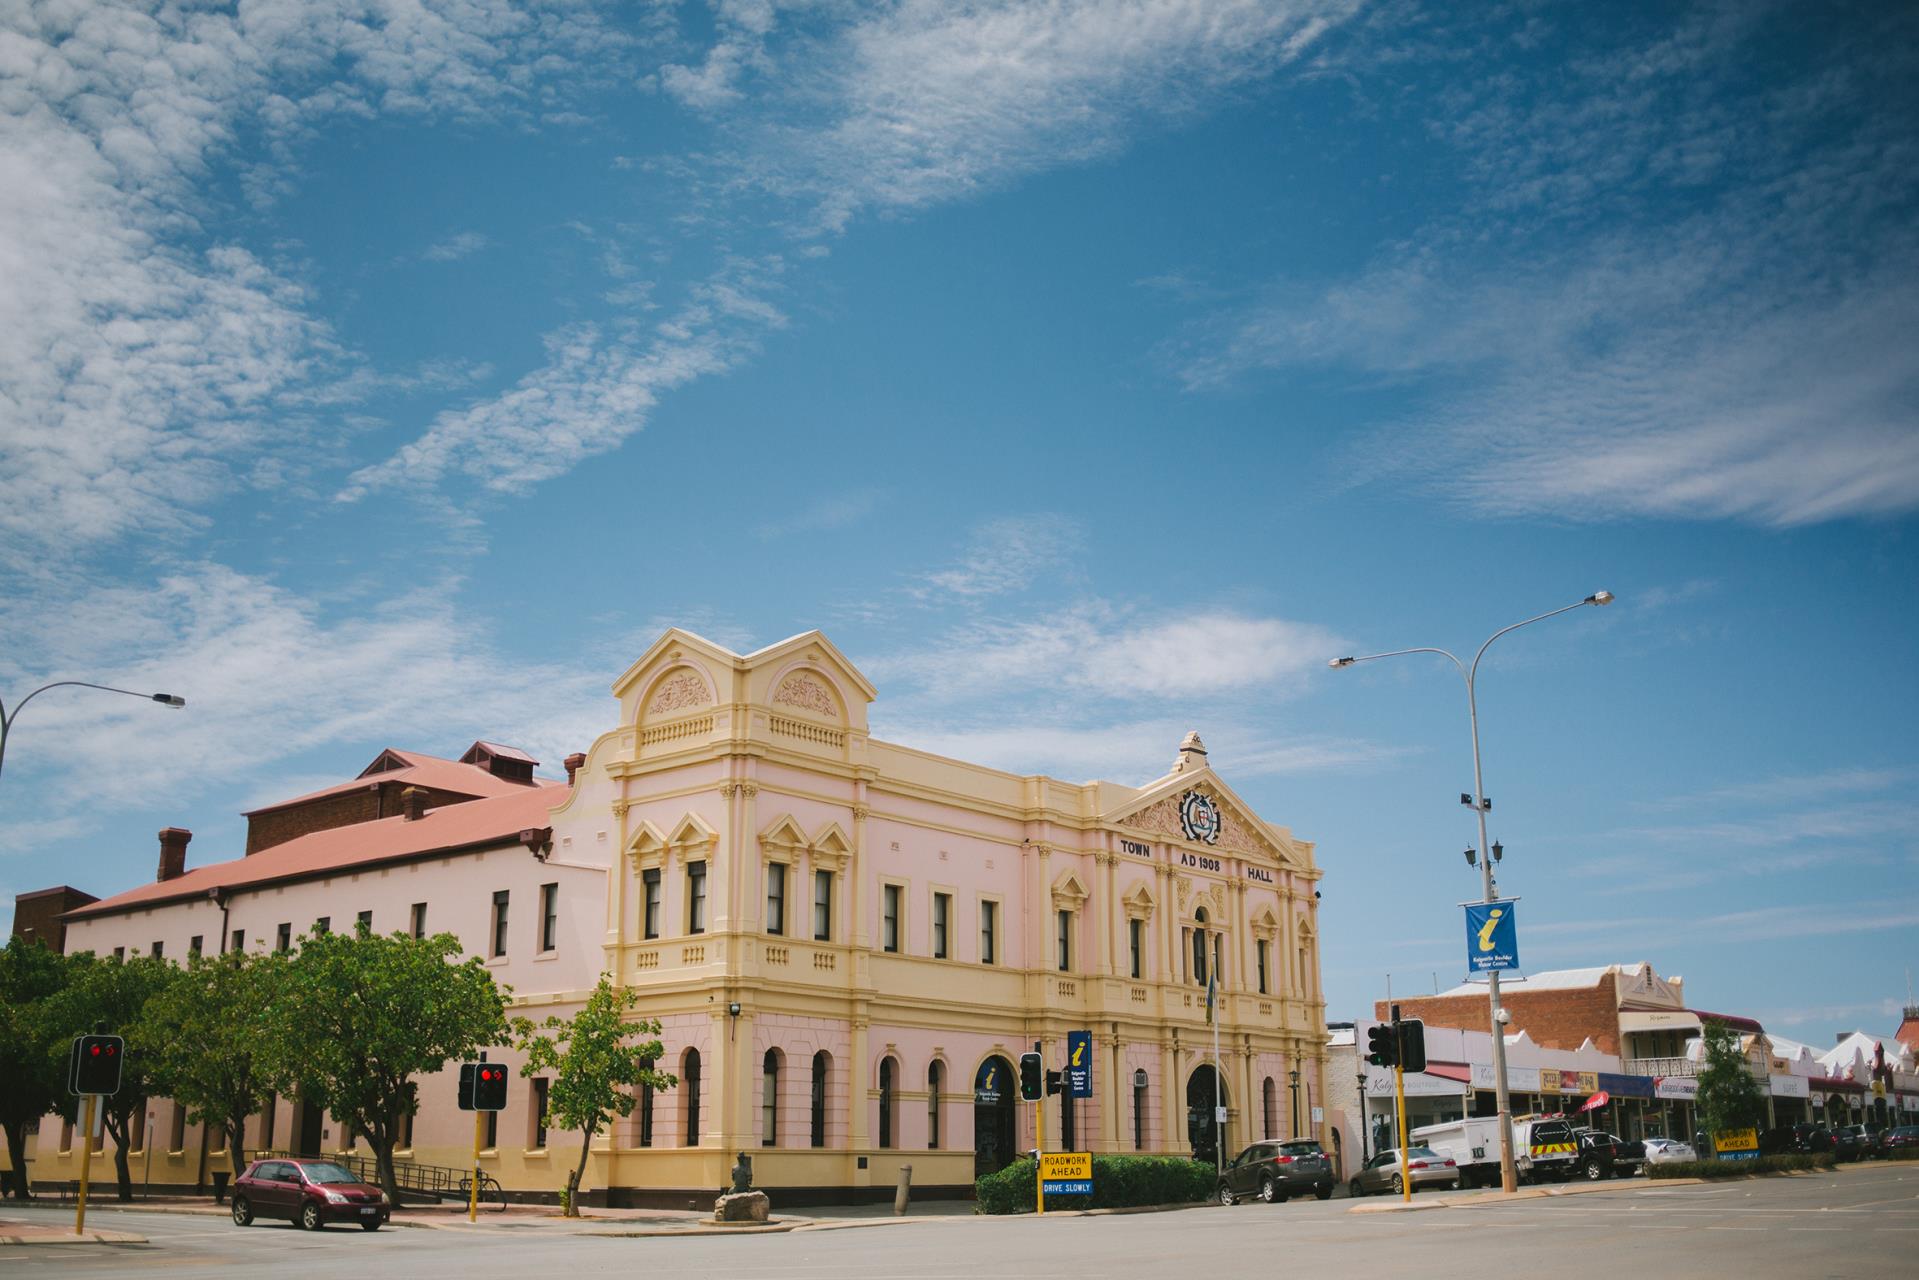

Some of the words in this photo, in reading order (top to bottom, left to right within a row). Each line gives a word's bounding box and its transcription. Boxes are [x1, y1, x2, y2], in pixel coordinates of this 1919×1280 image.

[1121, 840, 1150, 857] TOWN
[1181, 853, 1196, 867] AD
[1199, 857, 1220, 872] 1908
[1248, 867, 1273, 883] HALL
[1724, 1140, 1750, 1148] AHEAD
[1045, 1156, 1087, 1166] ROADWORK
[1050, 1167, 1083, 1176] AHEAD
[1044, 1182, 1064, 1192] DRIVE
[1065, 1182, 1090, 1193] SLOWLY
